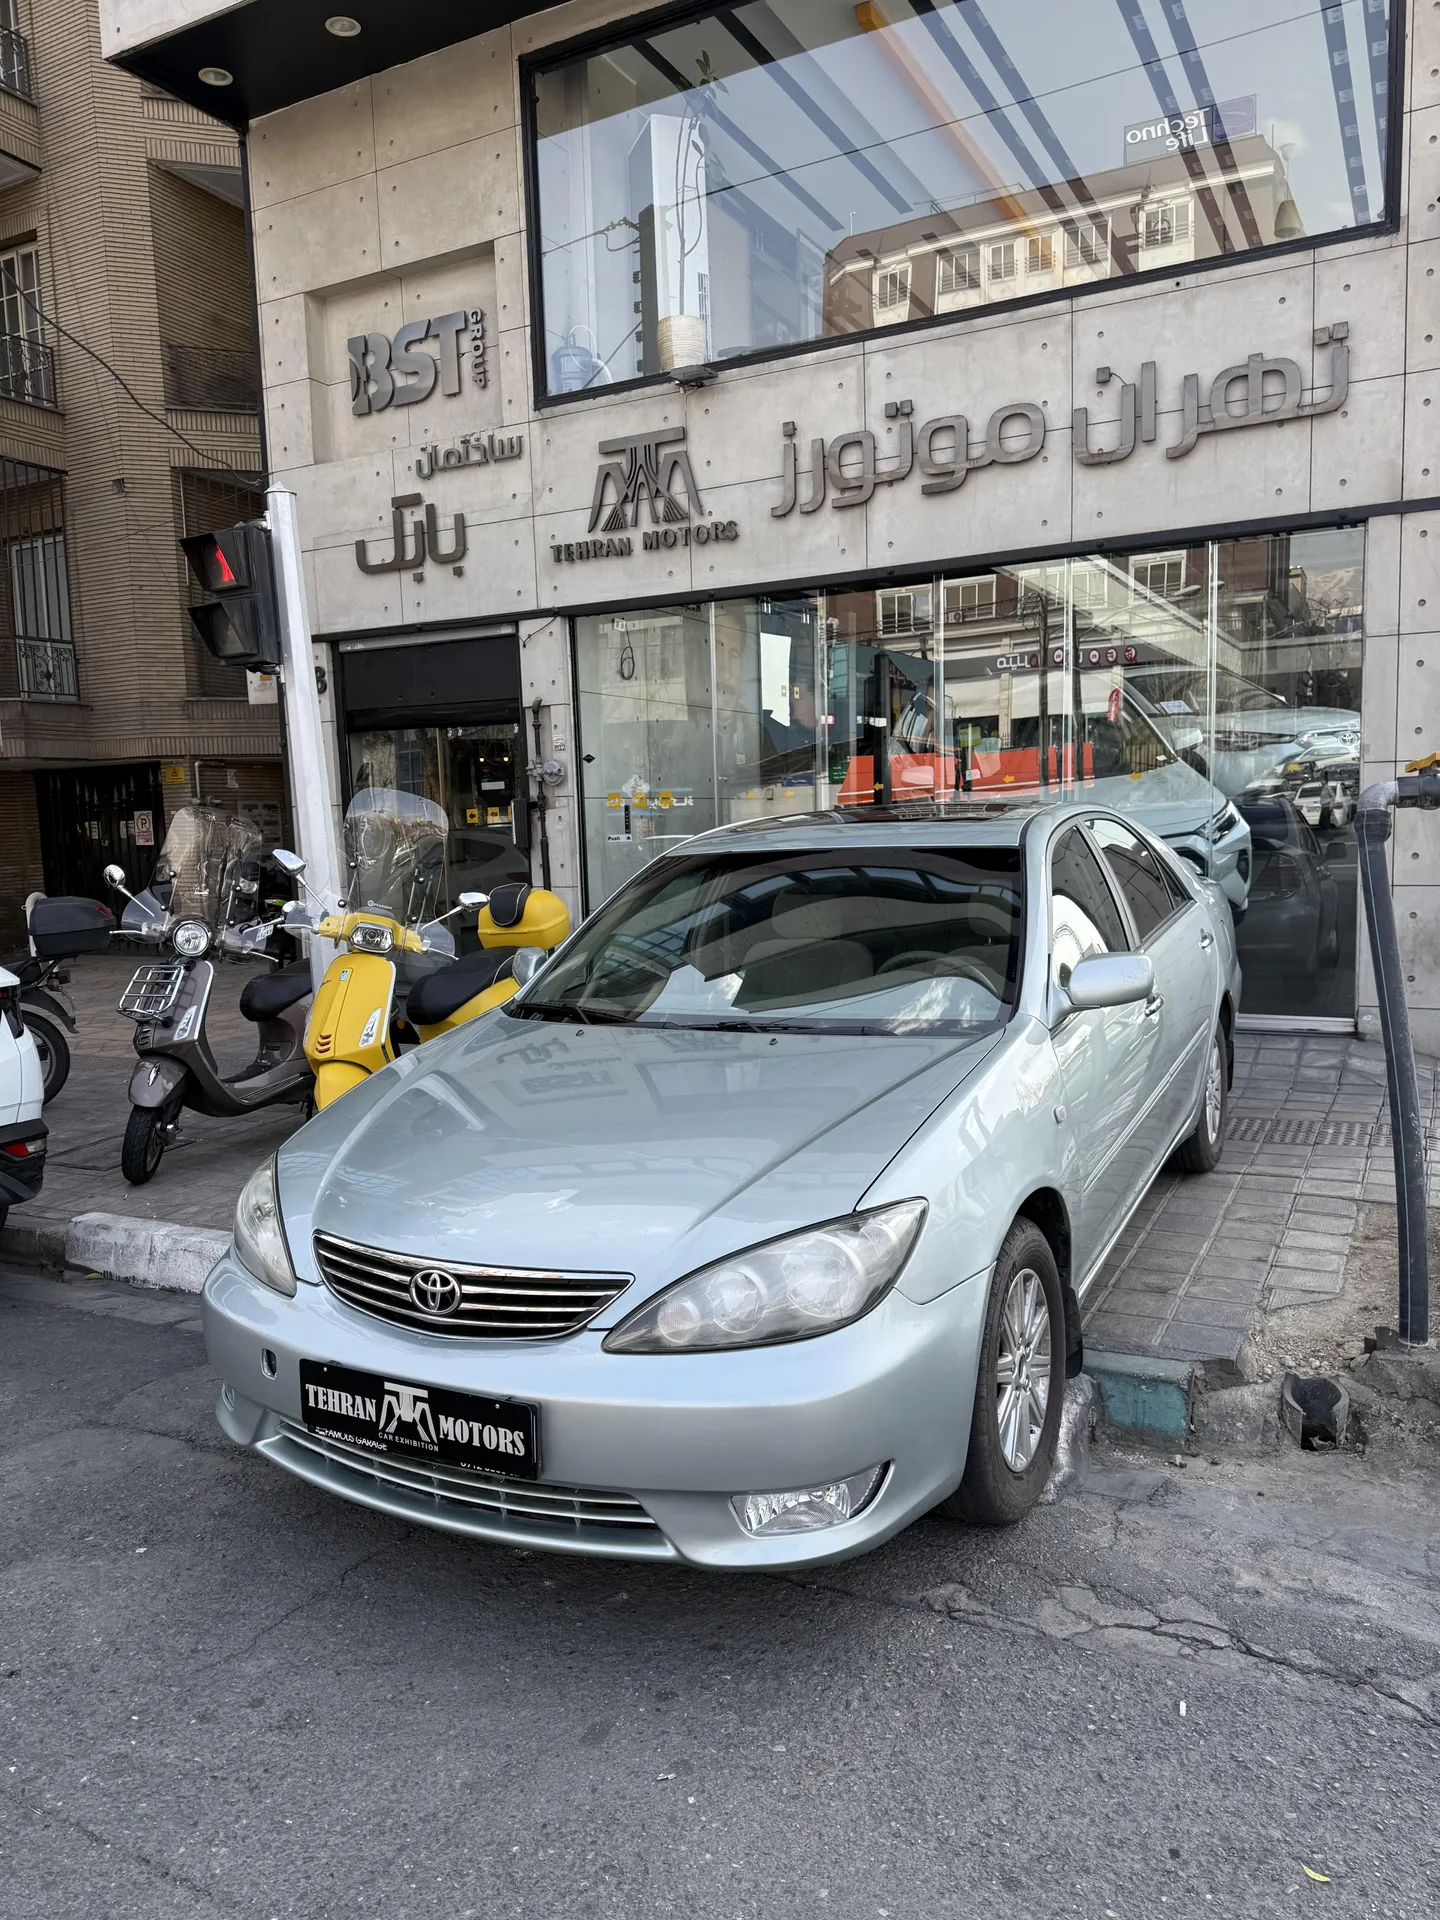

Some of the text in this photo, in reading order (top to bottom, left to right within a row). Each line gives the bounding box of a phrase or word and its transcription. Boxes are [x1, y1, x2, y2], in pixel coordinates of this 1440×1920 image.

[347, 310, 467, 416] BST
[469, 306, 487, 389] GROUP
[415, 434, 523, 479] ساختمان
[771, 321, 1350, 517] تهران موتورز
[355, 492, 465, 583] بابک
[550, 520, 739, 564] TEHRAN MOTORS
[305, 1383, 525, 1457] TEHRAN MOTORS
[378, 1431, 439, 1452] CAR EXHIBITION
